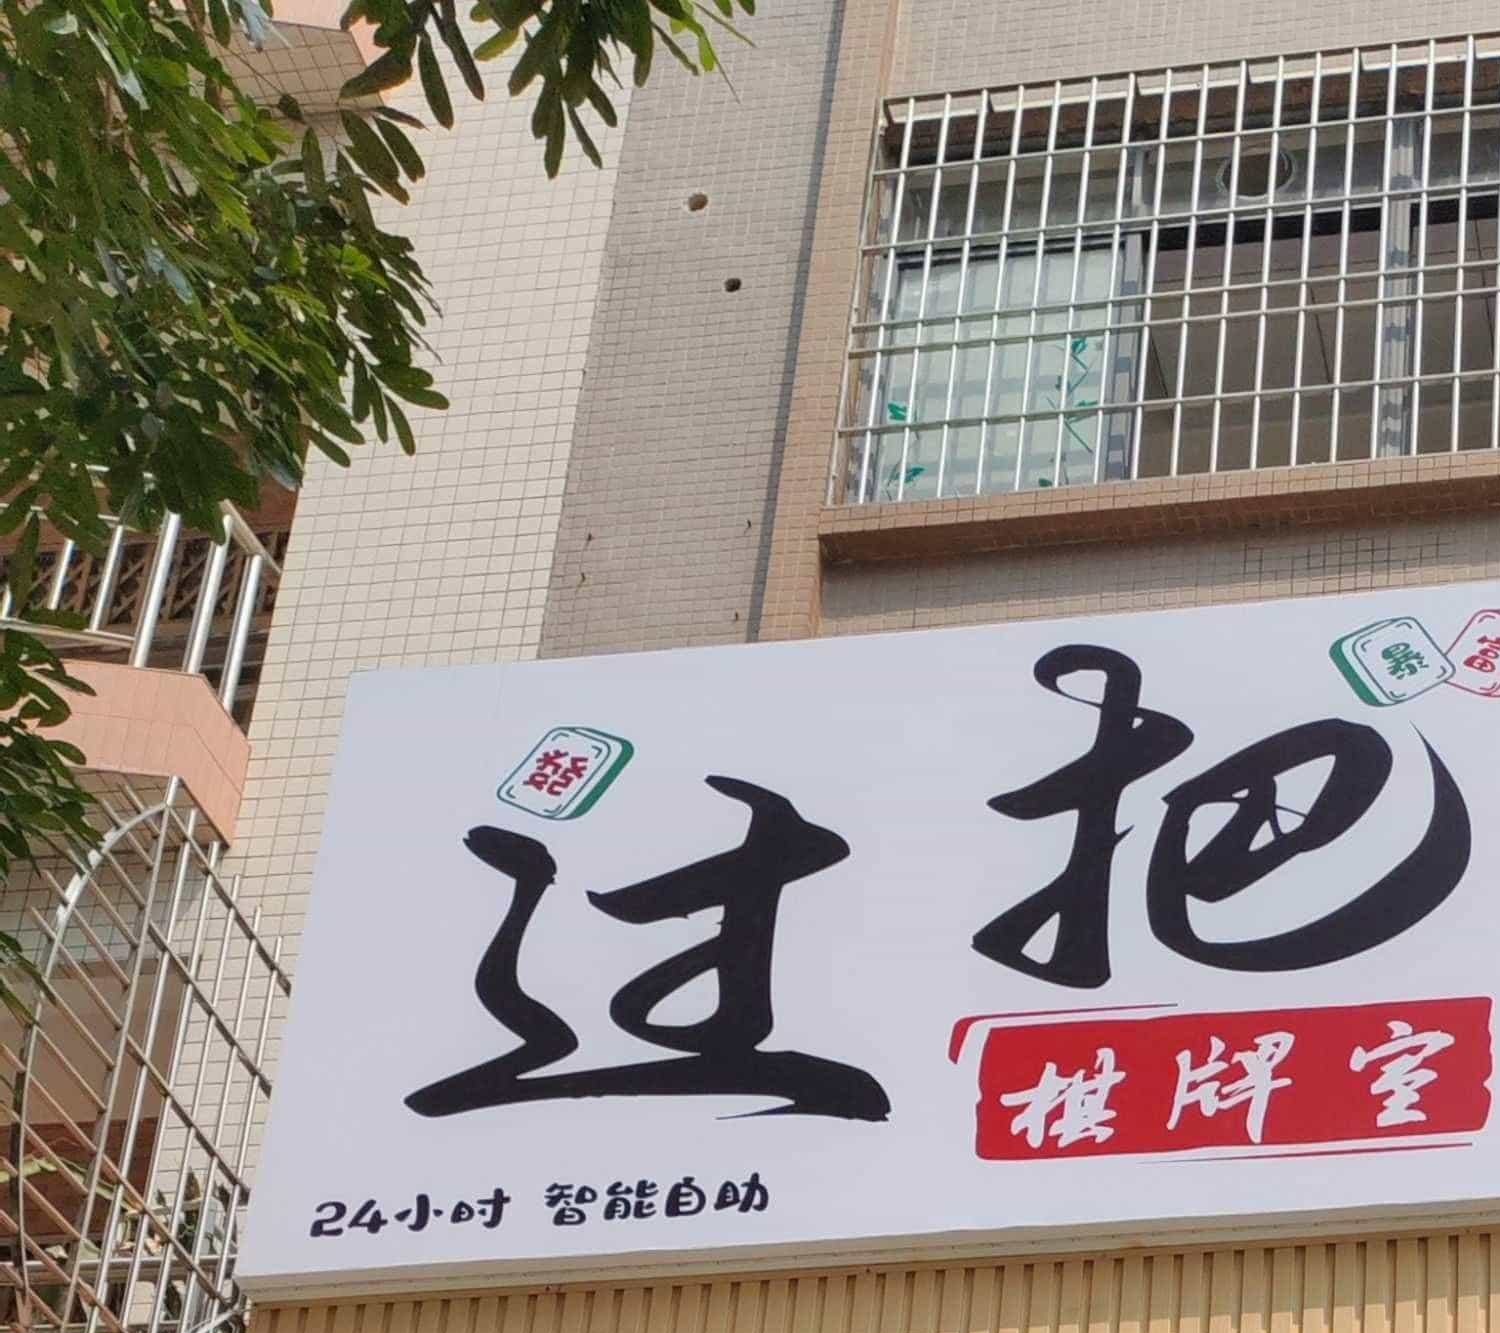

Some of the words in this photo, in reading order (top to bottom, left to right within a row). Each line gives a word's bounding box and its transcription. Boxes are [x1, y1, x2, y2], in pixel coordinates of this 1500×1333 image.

[999, 1019, 1455, 1148] 棋牌室
[309, 1188, 511, 1237] 24小时
[544, 1173, 769, 1226] 智能自助
